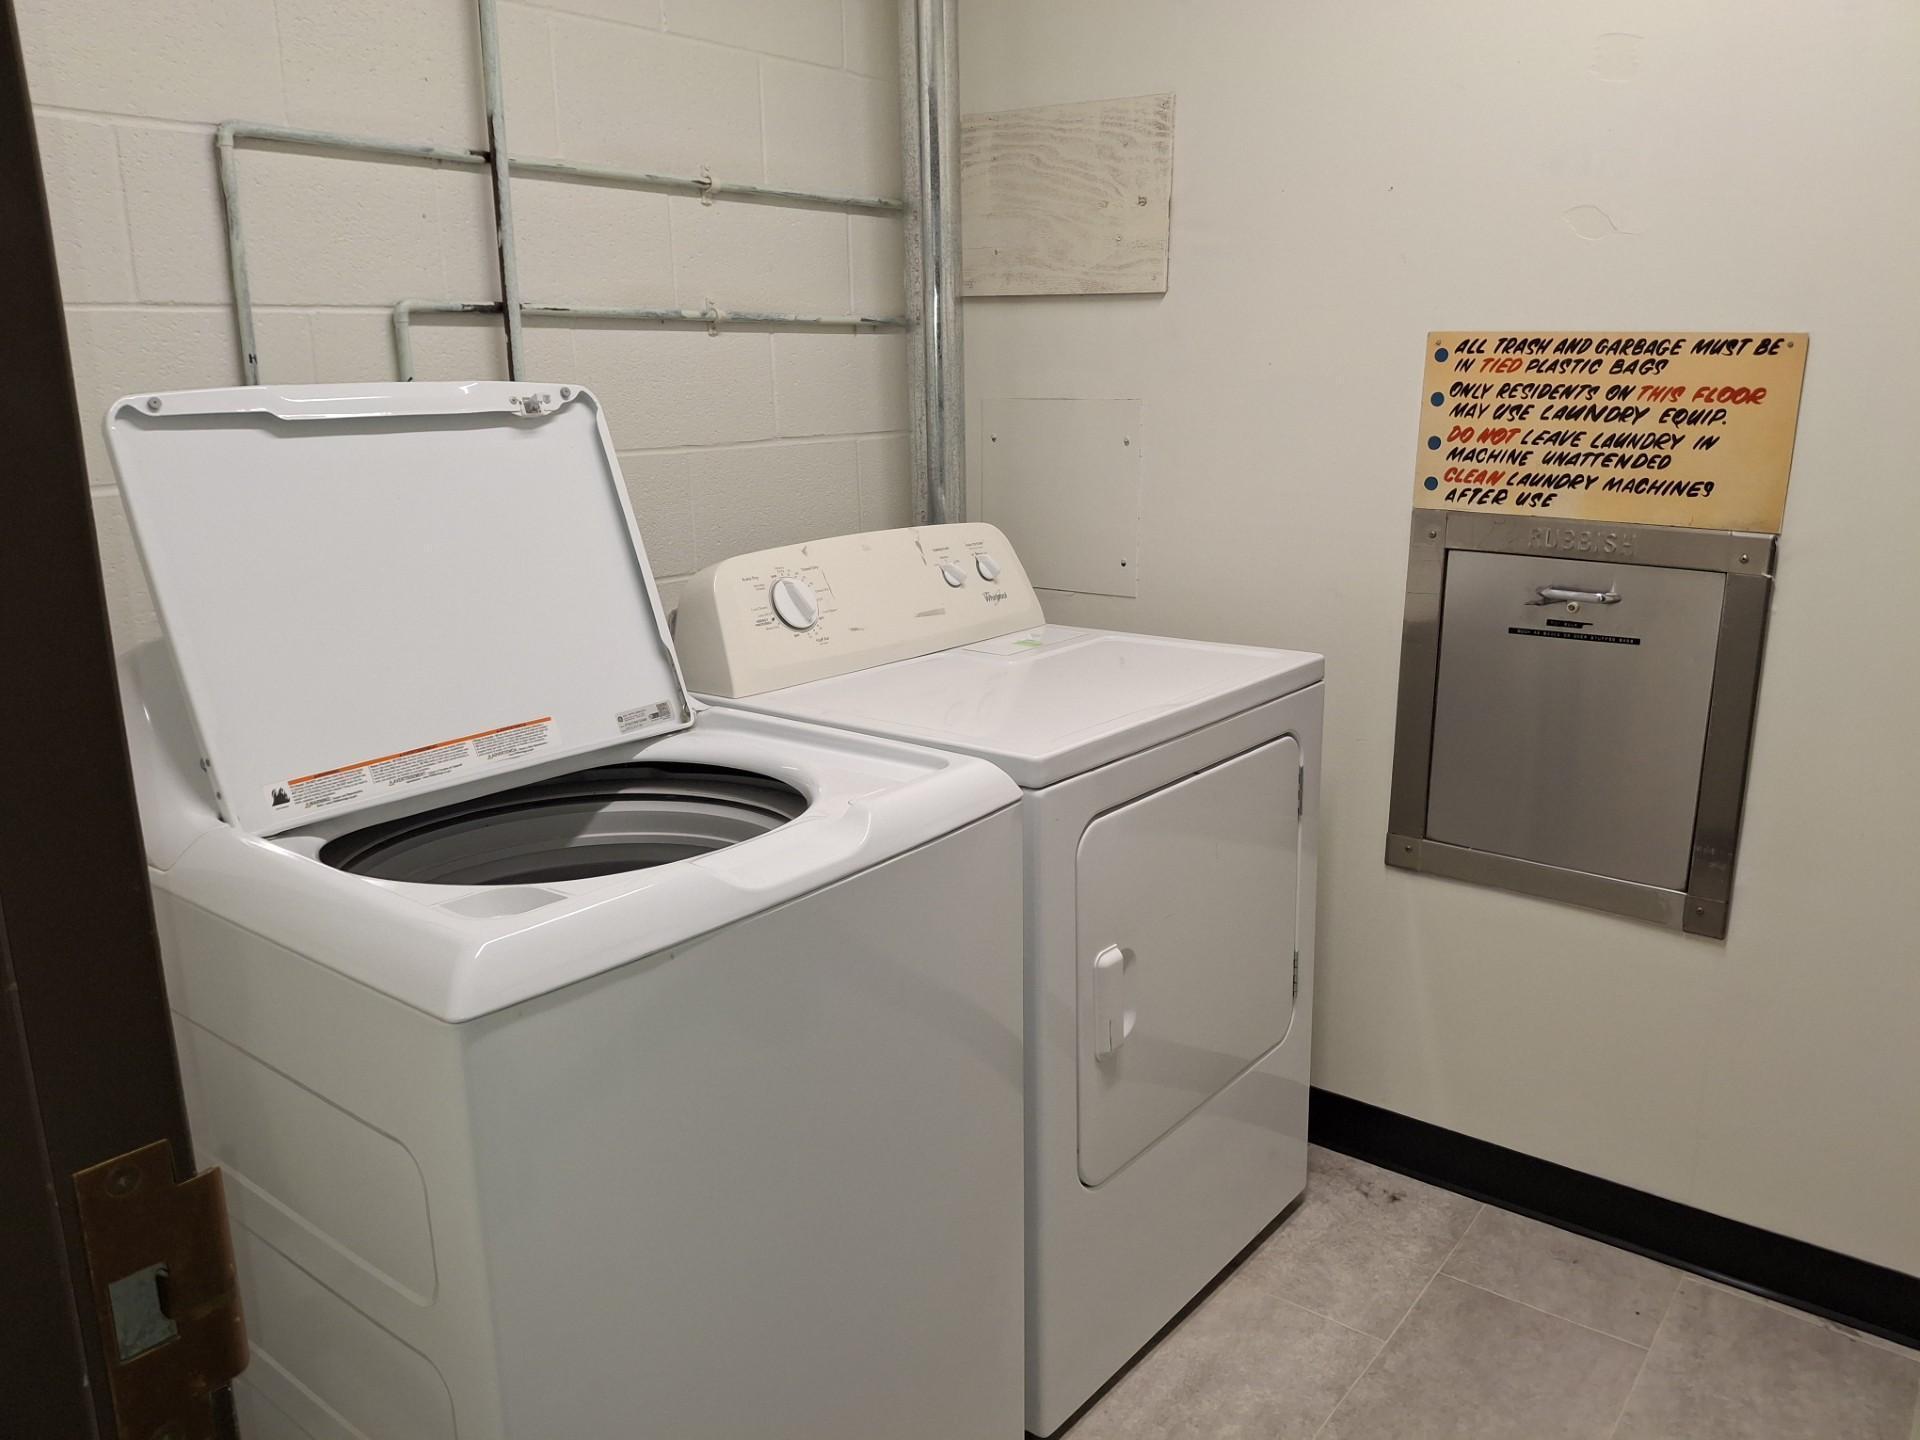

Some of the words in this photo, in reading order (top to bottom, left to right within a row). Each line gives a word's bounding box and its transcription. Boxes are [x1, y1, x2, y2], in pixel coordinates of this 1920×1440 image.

[1454, 338, 1488, 355] ALL
[1493, 337, 1554, 355] TRASH
[1552, 337, 1593, 356] AND
[1594, 338, 1686, 356] GARBAGE
[1690, 338, 1753, 356] MUST
[1752, 338, 1785, 356] BE
[1454, 358, 1476, 373] IN
[1479, 357, 1523, 374] TIED
[1524, 358, 1603, 375] PLASTIC
[1608, 358, 1669, 375] BAGS
[1449, 381, 1494, 399] ONLY
[1495, 382, 1601, 401] RESIDENTS
[1604, 384, 1636, 401] ON
[1636, 384, 1686, 403] THIS
[1691, 385, 1768, 405] FLOOR
[1449, 402, 1490, 419] MAY
[1492, 403, 1535, 422] USE
[1539, 403, 1651, 426] LAUNDRY
[1658, 407, 1728, 429] EQUIP.
[1446, 425, 1475, 444] DO
[1476, 427, 1521, 446] NOT
[1520, 428, 1587, 448] LEAVE
[1590, 431, 1686, 451] LAUNDRY
[1692, 435, 1720, 451] IN
[1446, 446, 1534, 467] MACHINE
[1541, 450, 1672, 470] UNATTENDED
[1443, 467, 1506, 487] CLEAN
[1506, 471, 1600, 490] LAUNDRY
[1601, 476, 1715, 498] MACHINES
[1444, 487, 1509, 506] AFTER
[1515, 491, 1558, 508] USE
